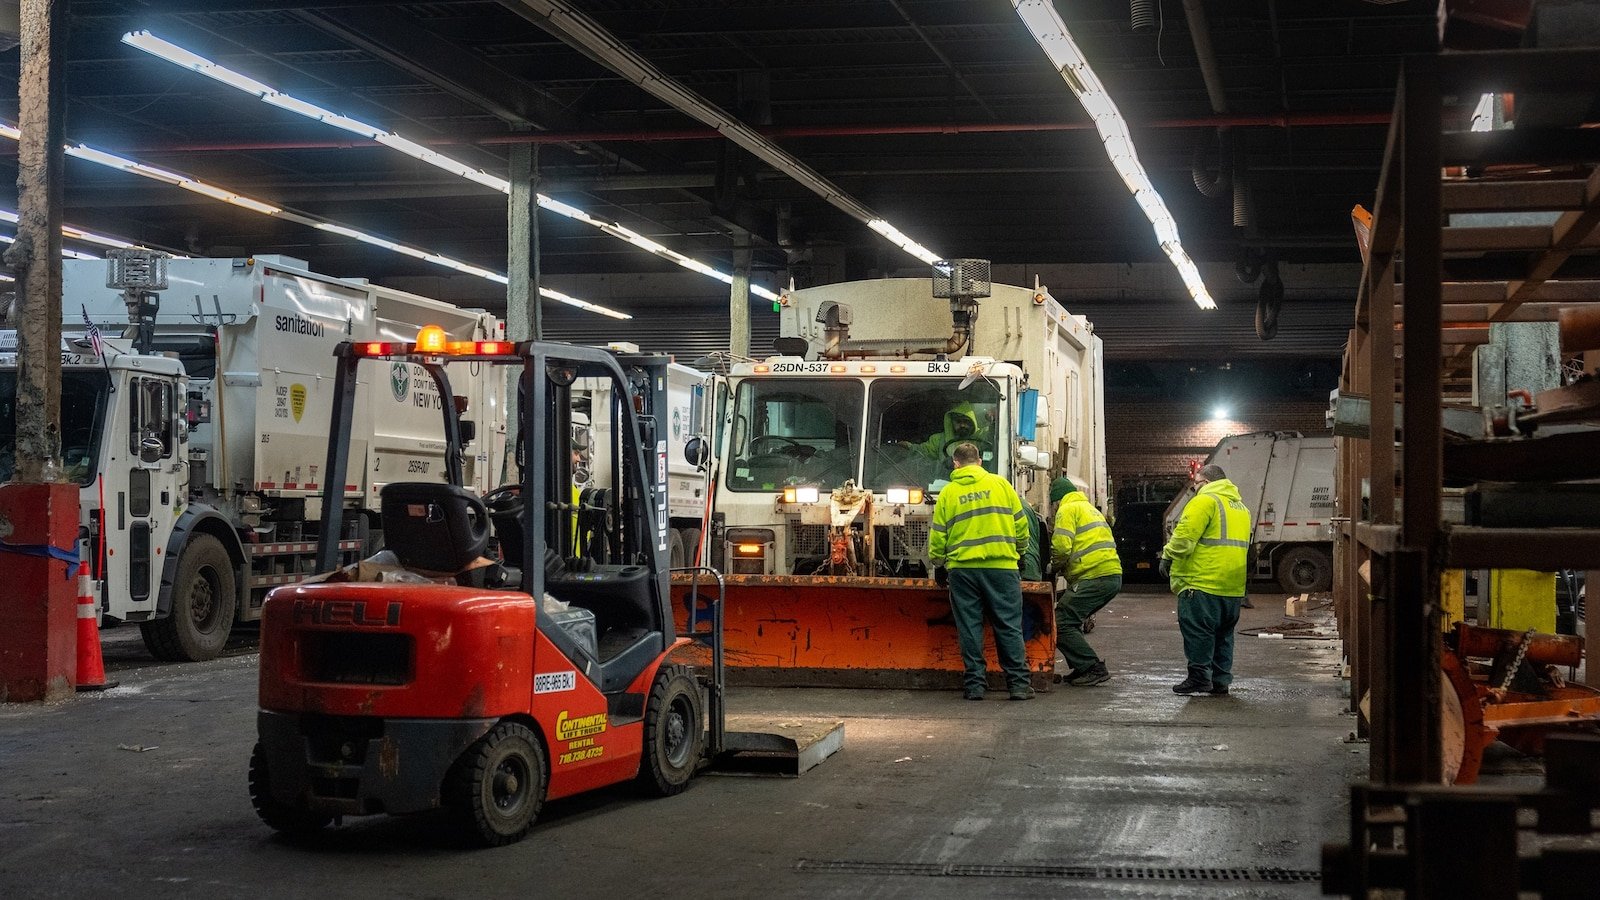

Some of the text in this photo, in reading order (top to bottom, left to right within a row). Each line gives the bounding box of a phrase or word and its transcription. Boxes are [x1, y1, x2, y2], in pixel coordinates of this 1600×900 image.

[275, 313, 324, 337] sanitation
[773, 363, 829, 373] 25DN-537
[927, 363, 950, 373] Bk.9
[413, 378, 427, 390] DON'T
[413, 392, 442, 410] NEW YO
[958, 490, 991, 505] DSNY
[657, 485, 667, 552] HELI
[294, 600, 403, 628] HELI
[563, 725, 603, 739] LIFT TRUCK
[568, 737, 595, 750] RENTAL
